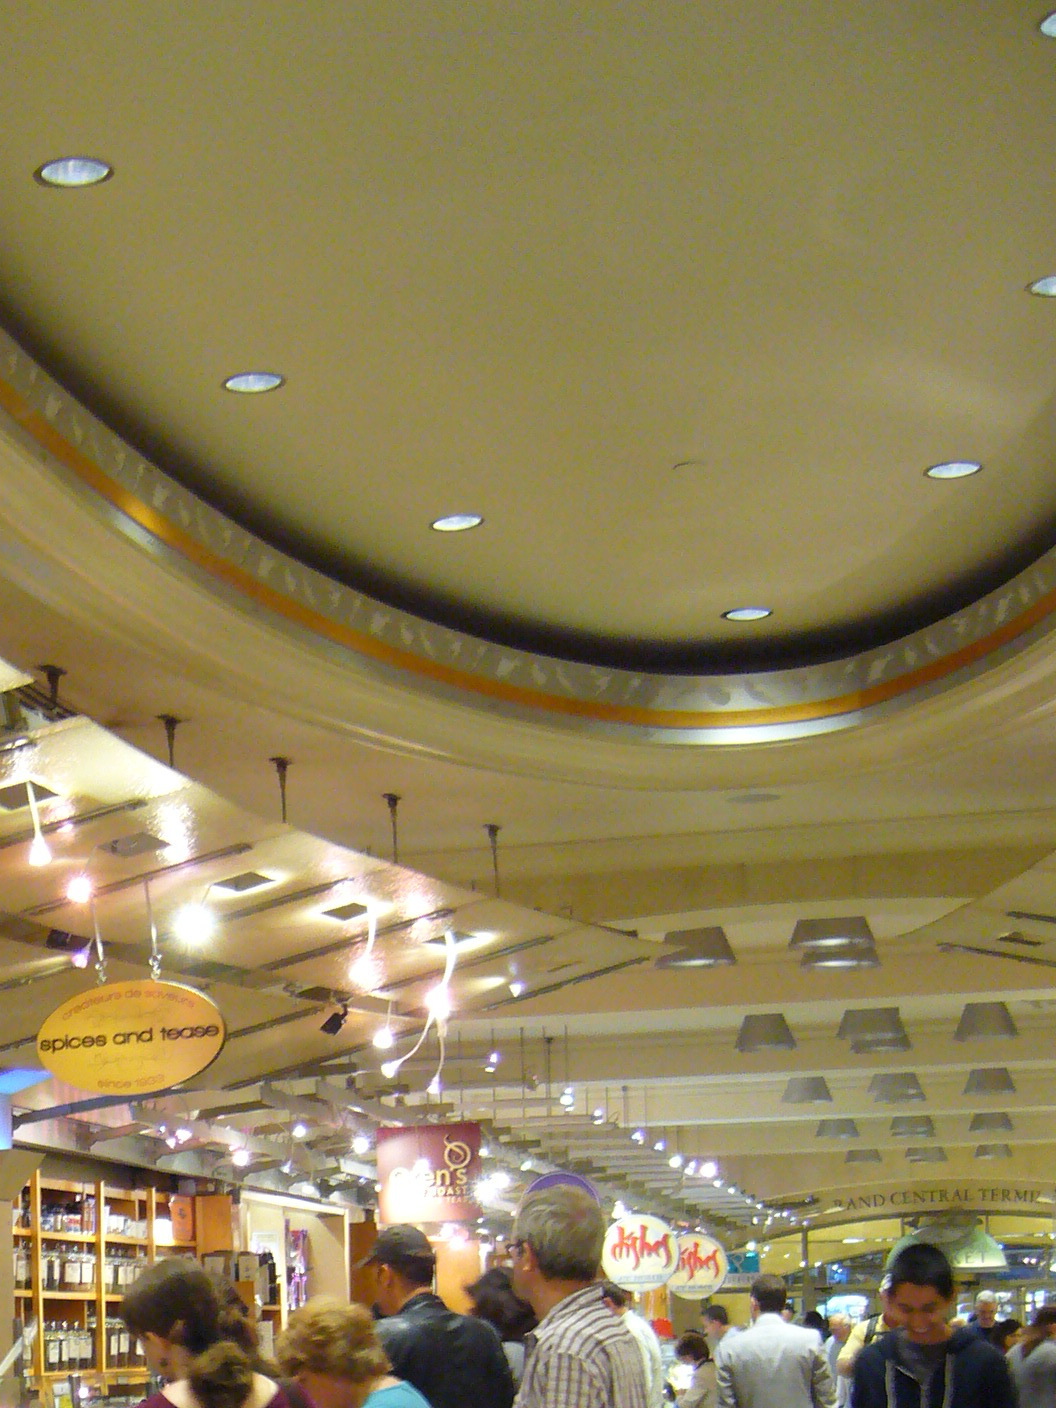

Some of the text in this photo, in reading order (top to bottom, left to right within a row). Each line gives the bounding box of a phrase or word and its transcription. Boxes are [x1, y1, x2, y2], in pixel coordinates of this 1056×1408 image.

[39, 1023, 220, 1054] spices and tease
[96, 1078, 132, 1089] since
[890, 1188, 971, 1206] CENTRAL
